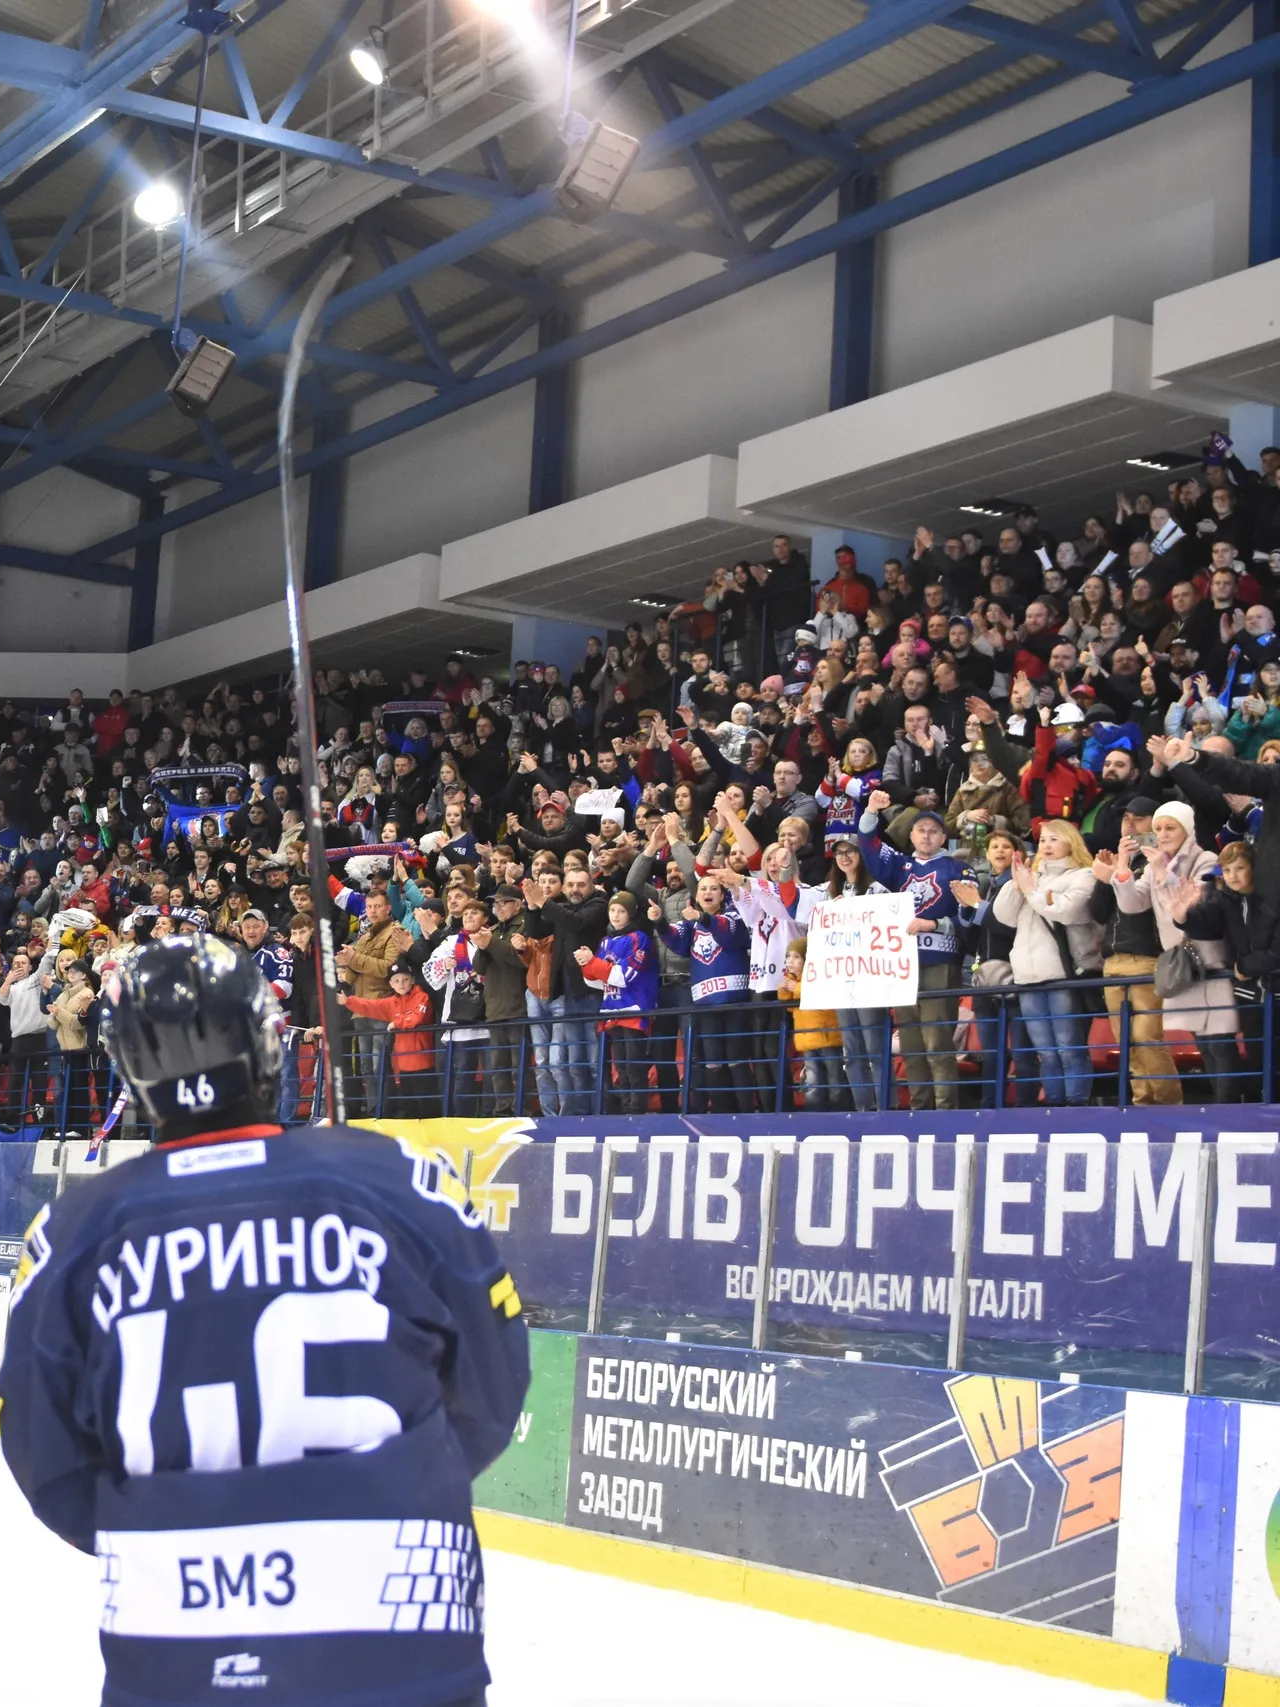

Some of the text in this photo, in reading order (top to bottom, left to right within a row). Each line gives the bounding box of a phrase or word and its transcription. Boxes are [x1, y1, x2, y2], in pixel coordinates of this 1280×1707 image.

[824, 926, 903, 953] ХОТИМ 25
[700, 978, 728, 995] 2013
[806, 956, 910, 982] В СТОЛИЦУ
[176, 1074, 216, 1106] 46
[923, 1276, 1043, 1321] МТАЛЛ
[116, 1289, 404, 1476] 46
[586, 1356, 776, 1420] БЕЛОРУССКИЙ
[581, 1414, 868, 1498] МЕТАЛЛУРГИЧЕСКИЙ
[578, 1472, 664, 1533] ЗАВОД
[178, 1549, 297, 1611] БМЗ
